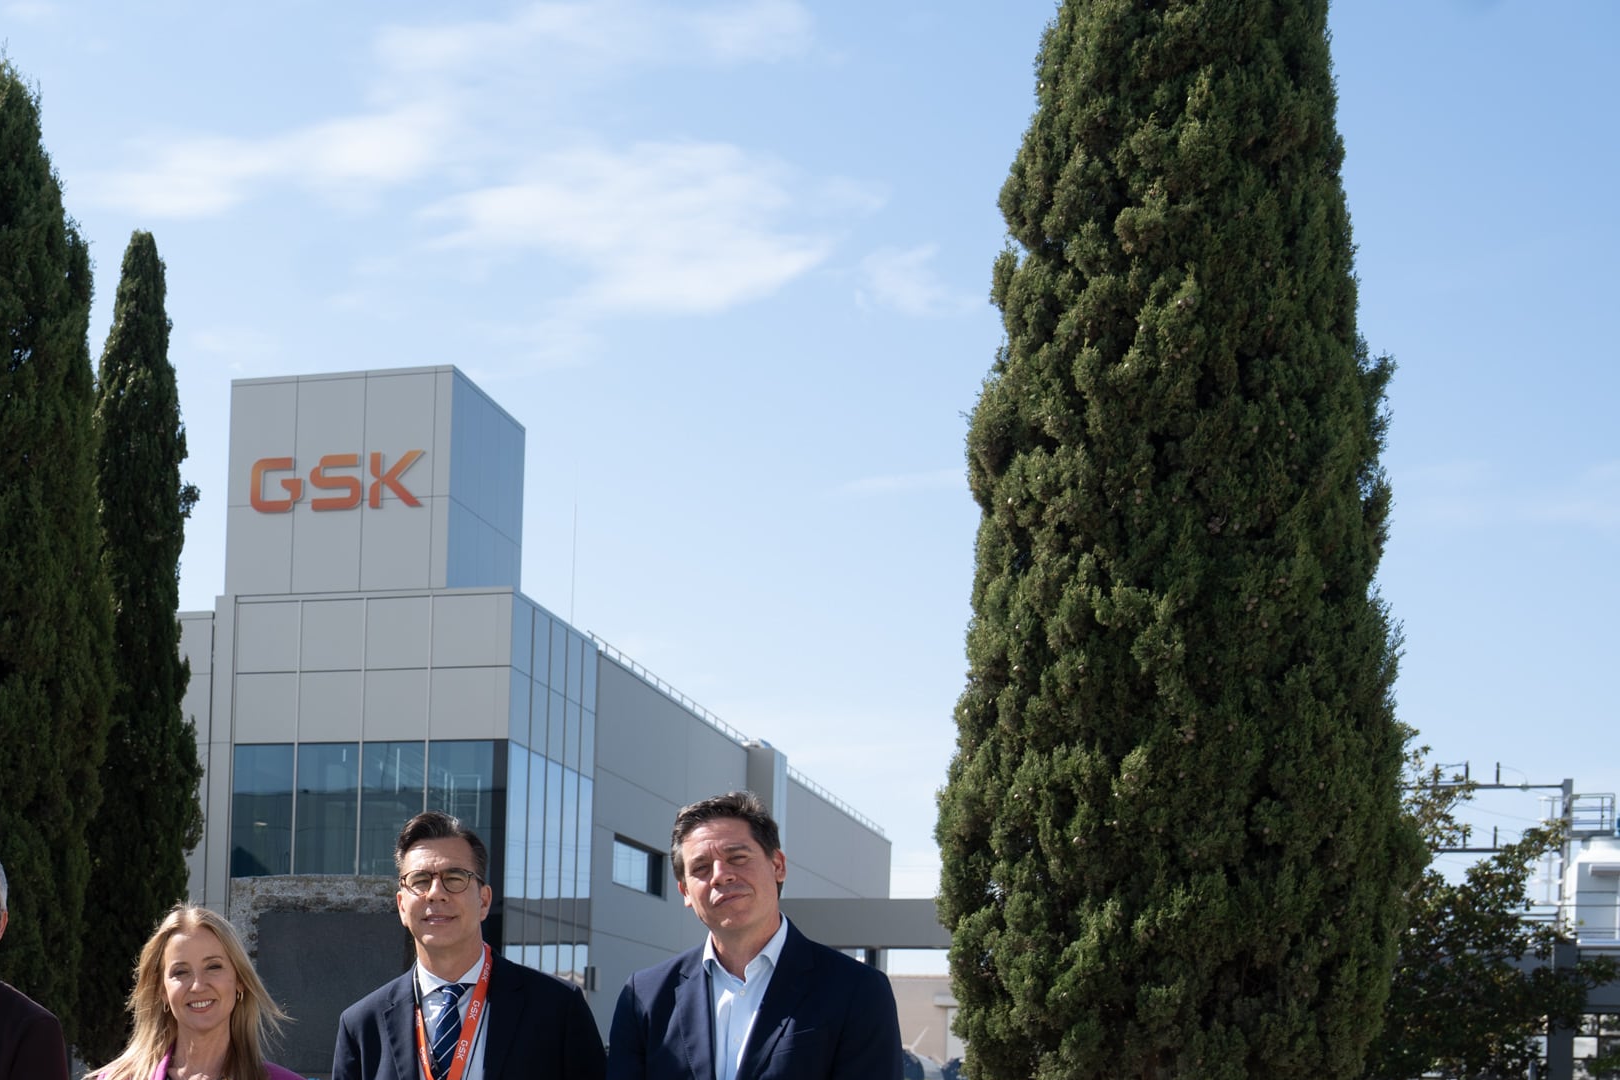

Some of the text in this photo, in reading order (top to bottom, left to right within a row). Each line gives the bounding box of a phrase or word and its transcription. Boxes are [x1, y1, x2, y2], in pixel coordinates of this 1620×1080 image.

[250, 449, 426, 513] GSK
[468, 1000, 481, 1021] GSK
[456, 1039, 468, 1061] GSK
